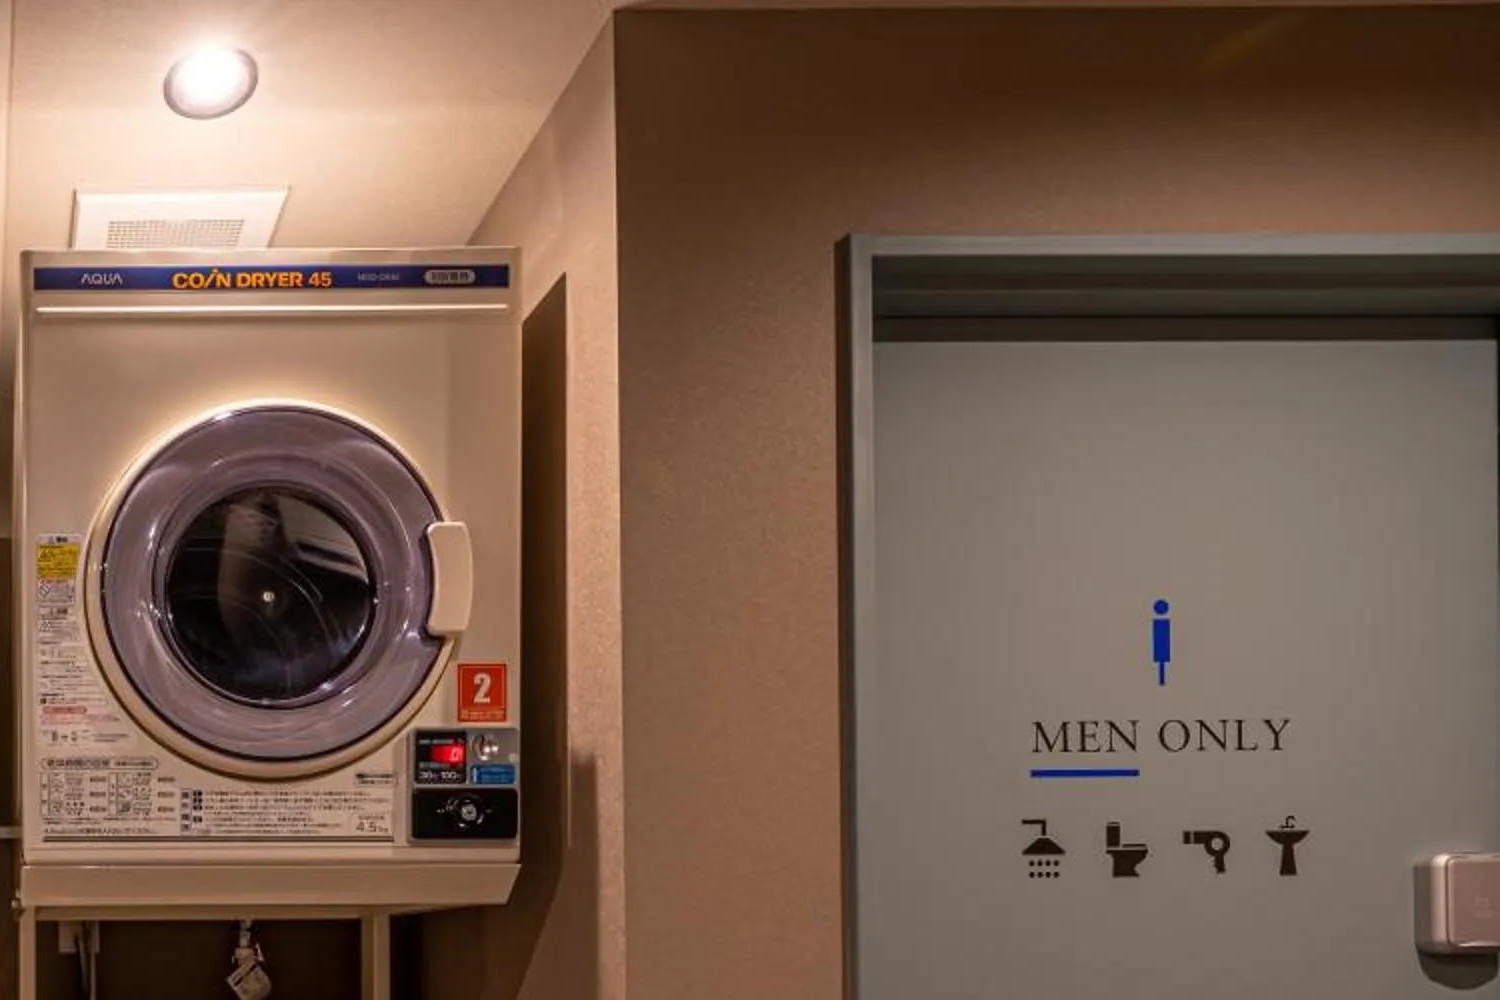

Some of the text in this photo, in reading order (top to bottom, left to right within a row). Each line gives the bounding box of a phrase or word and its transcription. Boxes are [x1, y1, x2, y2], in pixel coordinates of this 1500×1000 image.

[81, 273, 123, 285] AQUA
[236, 272, 303, 289] DRYER
[308, 272, 333, 288] 45
[473, 672, 491, 704] 2
[1031, 719, 1291, 753] MEN ONLY
